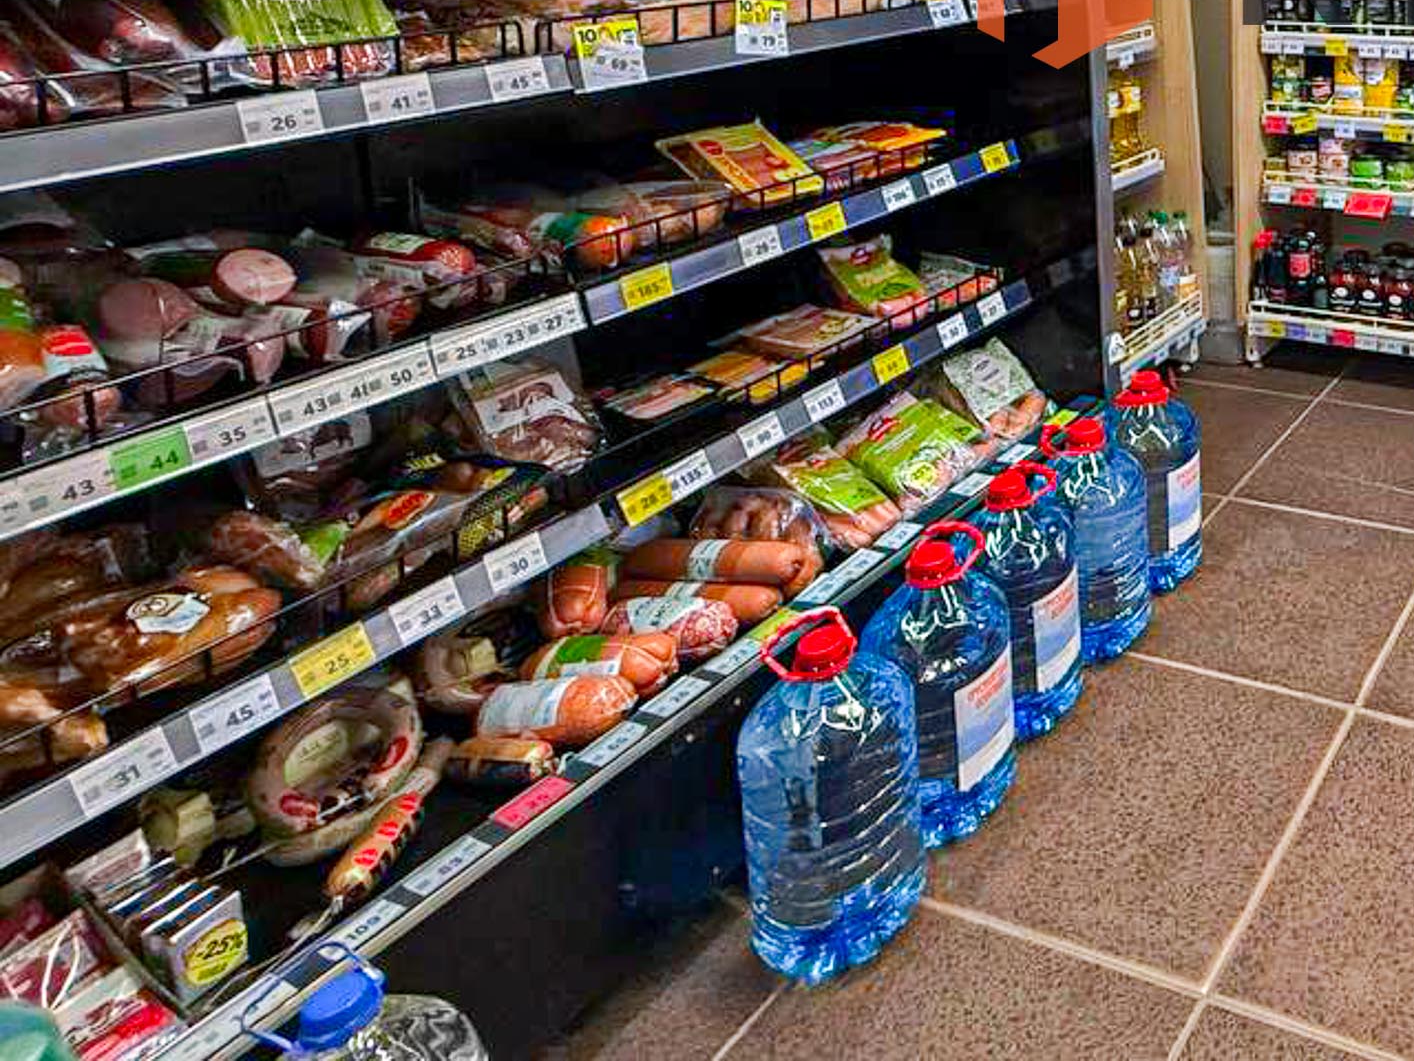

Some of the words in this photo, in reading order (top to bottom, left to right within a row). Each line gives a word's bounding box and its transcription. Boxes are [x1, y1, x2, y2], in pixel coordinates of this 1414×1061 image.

[577, 29, 598, 43] 10
[509, 75, 530, 90] 45
[390, 95, 413, 110] 41
[271, 115, 297, 132] 26
[545, 315, 564, 332] 27
[504, 329, 525, 346] 23
[455, 345, 477, 361] 25
[389, 369, 412, 388] 50
[350, 382, 370, 399] 41
[303, 396, 328, 417] 43
[218, 426, 247, 448] 35
[150, 449, 180, 471] 44
[62, 479, 96, 501] 43
[509, 556, 530, 576] 30
[420, 605, 444, 626] 33
[324, 653, 350, 675] 25
[226, 703, 255, 727] 45
[113, 764, 141, 790] 31
[347, 915, 382, 942] 109
